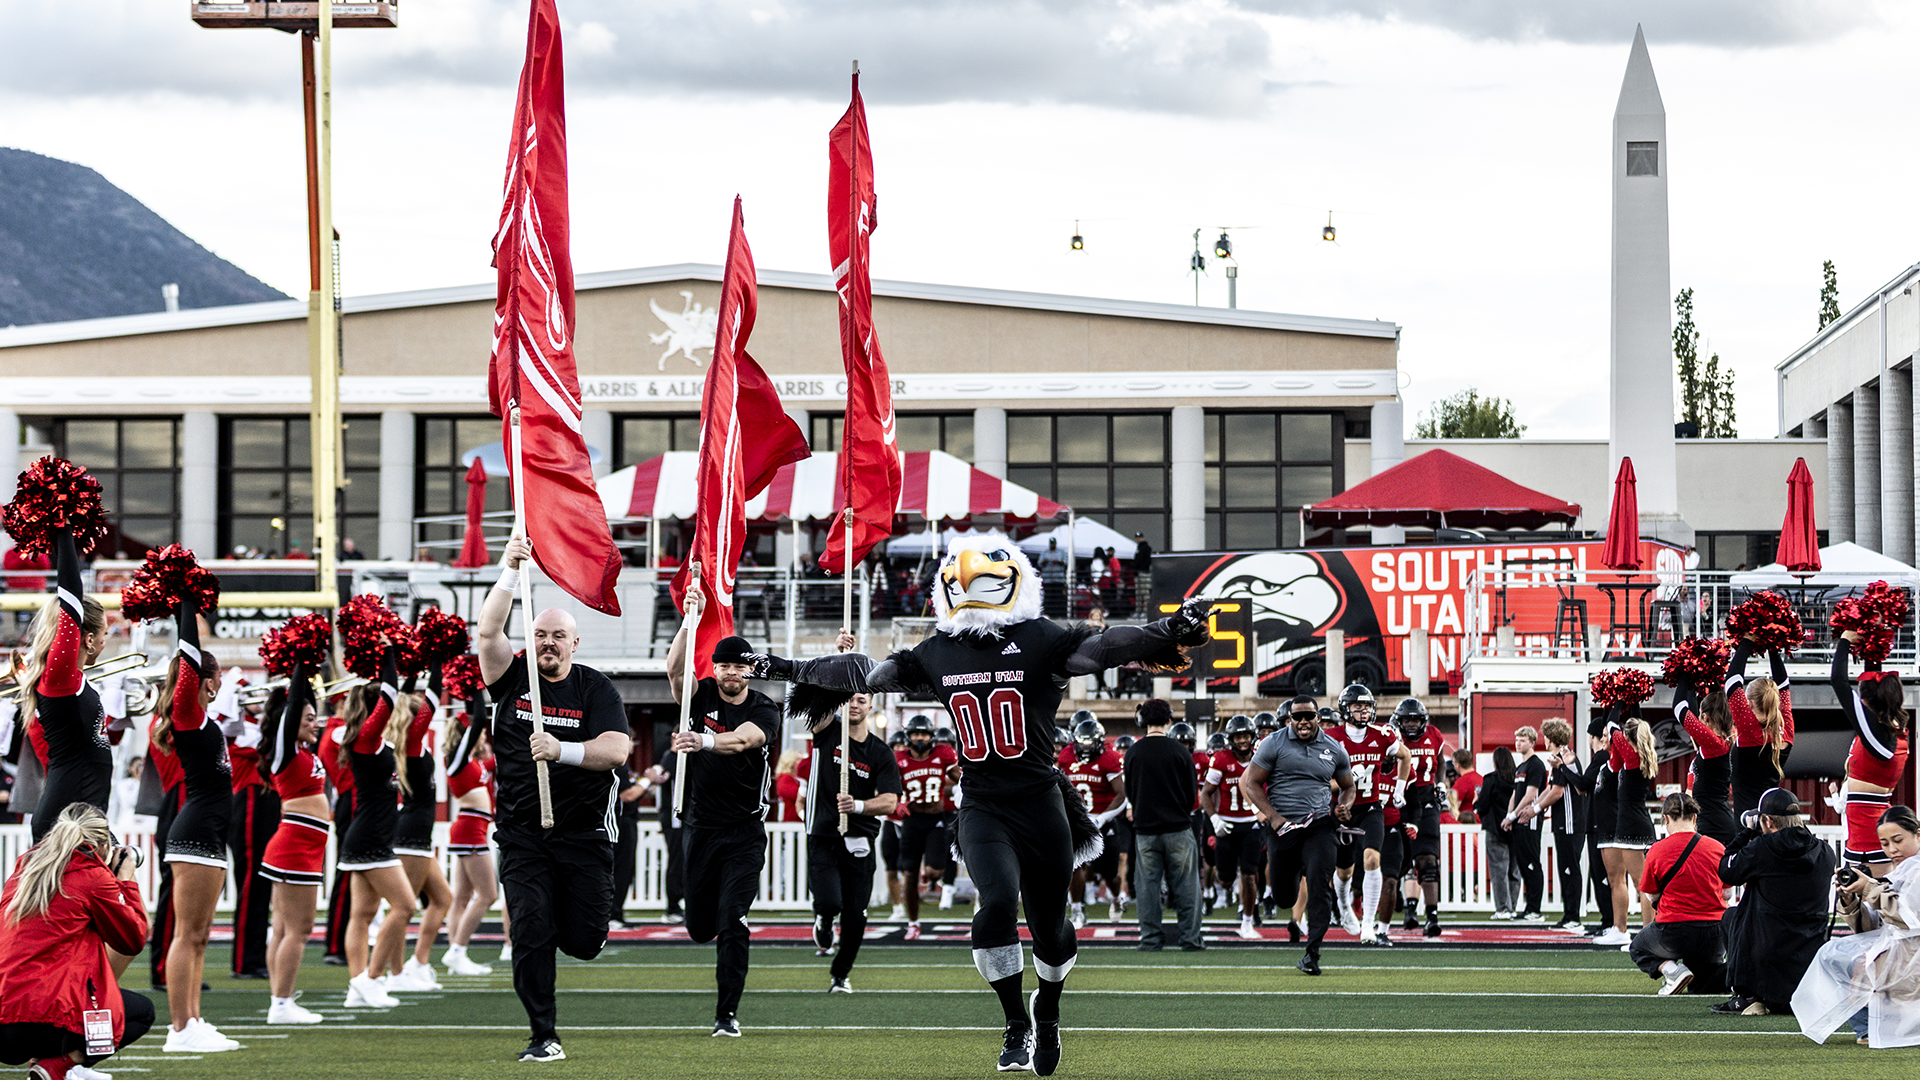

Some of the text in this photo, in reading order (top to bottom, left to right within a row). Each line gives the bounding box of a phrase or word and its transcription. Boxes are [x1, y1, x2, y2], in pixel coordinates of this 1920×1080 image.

[647, 382, 658, 397] &
[774, 381, 825, 396] ARRIS
[1371, 546, 1586, 593] SOUTHERN
[1387, 593, 1489, 635] UTAH
[942, 670, 1024, 687] SOUTHERN UTAH
[515, 699, 583, 719] SOUERN UTAH
[515, 709, 580, 728] THUERBIRDS
[949, 687, 1028, 762] 00
[906, 776, 942, 804] 28
[1358, 764, 1375, 798] 4
